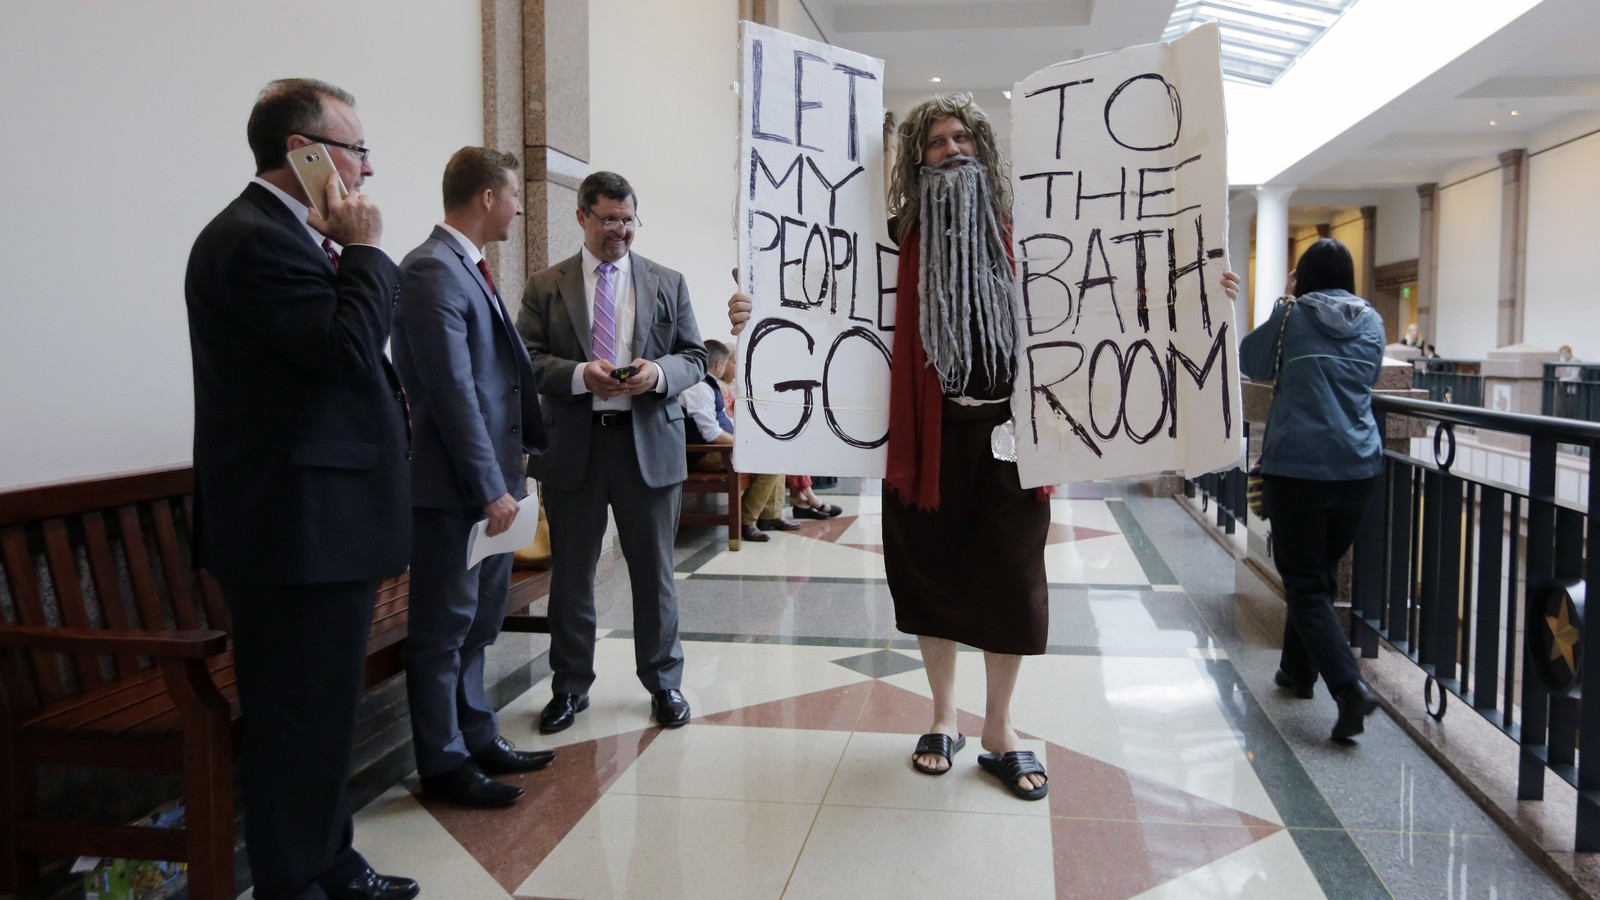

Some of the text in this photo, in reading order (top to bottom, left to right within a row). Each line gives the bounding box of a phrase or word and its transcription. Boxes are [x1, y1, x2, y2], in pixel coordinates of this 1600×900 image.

[752, 39, 877, 165] LET
[1025, 73, 1182, 159] TO
[750, 146, 865, 226] MY
[1020, 154, 1201, 221] THE
[748, 208, 900, 331] PEOPLE
[1018, 214, 1223, 338] BATH-
[745, 316, 892, 449] GO
[1024, 321, 1232, 459] ROOM
